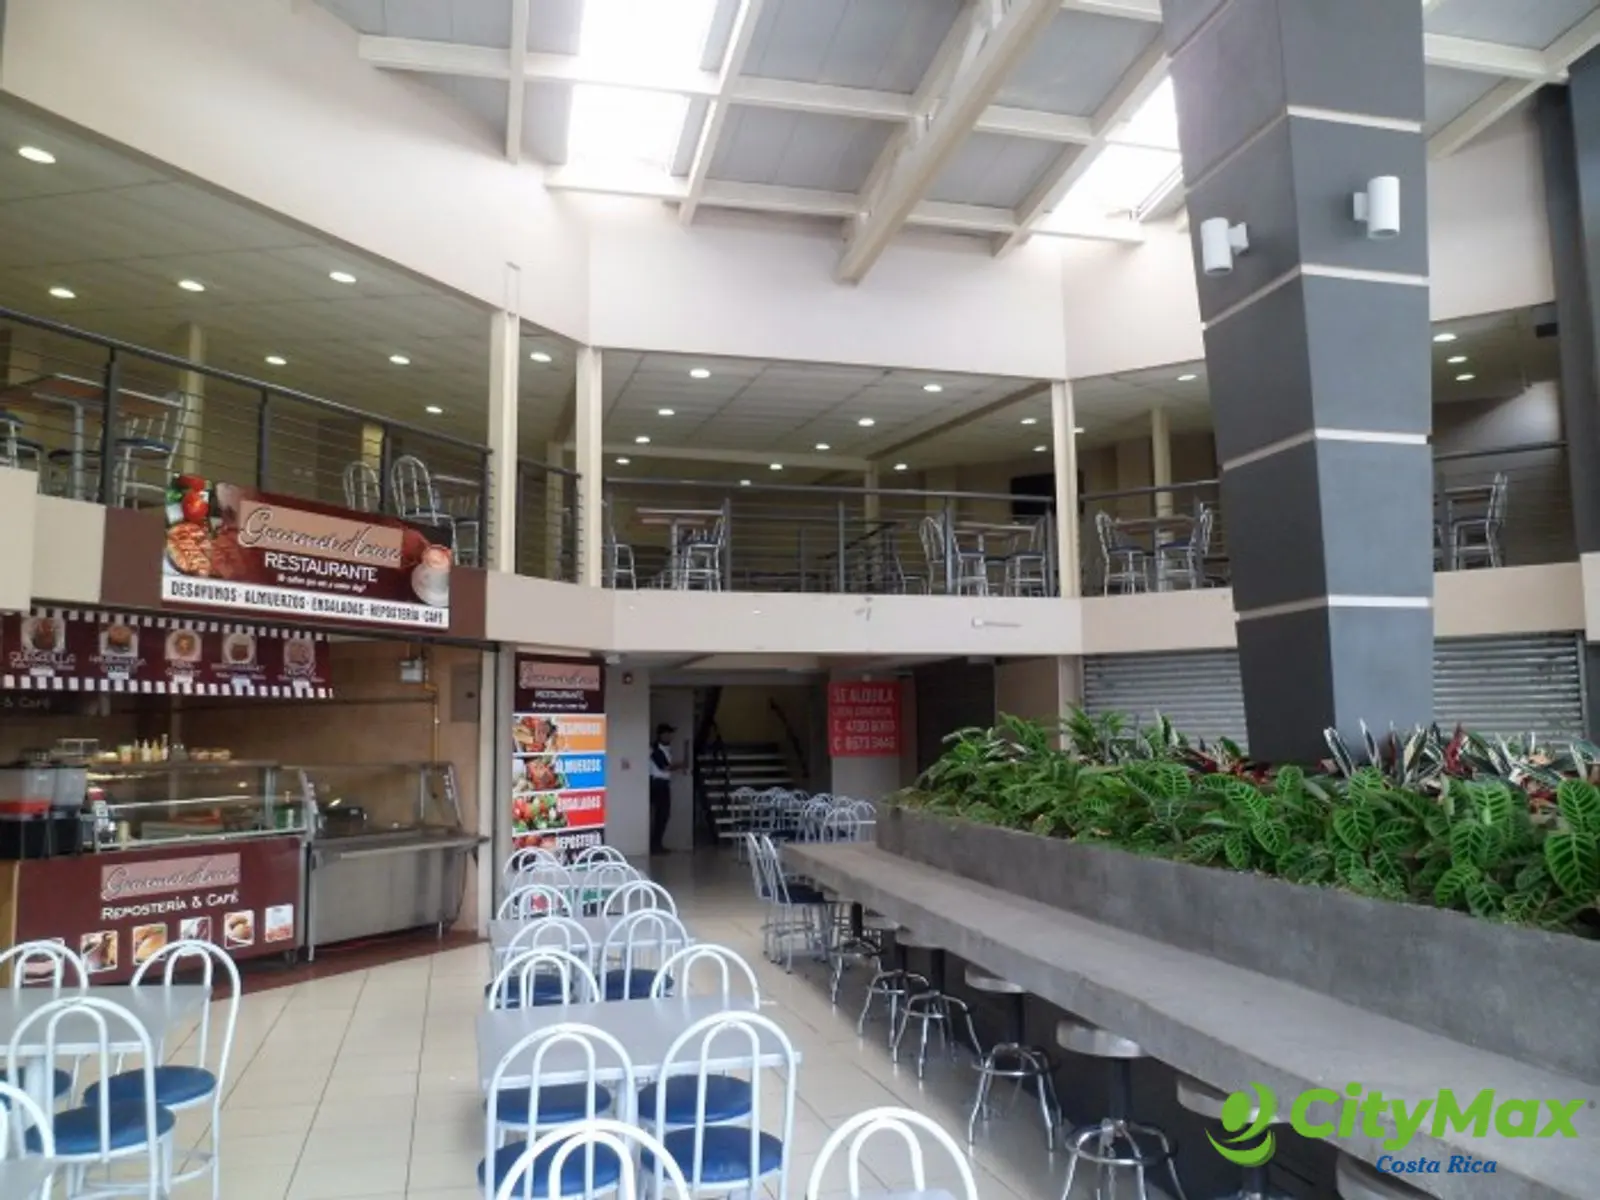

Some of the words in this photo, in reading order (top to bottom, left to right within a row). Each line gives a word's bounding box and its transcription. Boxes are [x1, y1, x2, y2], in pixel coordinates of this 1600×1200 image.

[264, 551, 378, 582] RESTAURANTE
[170, 580, 238, 602] DESAYUNOS
[243, 590, 307, 609] ALMUERZOS
[311, 597, 365, 616] ENSALADAS
[101, 895, 187, 921] REPOSTERÍA
[192, 895, 202, 908] &
